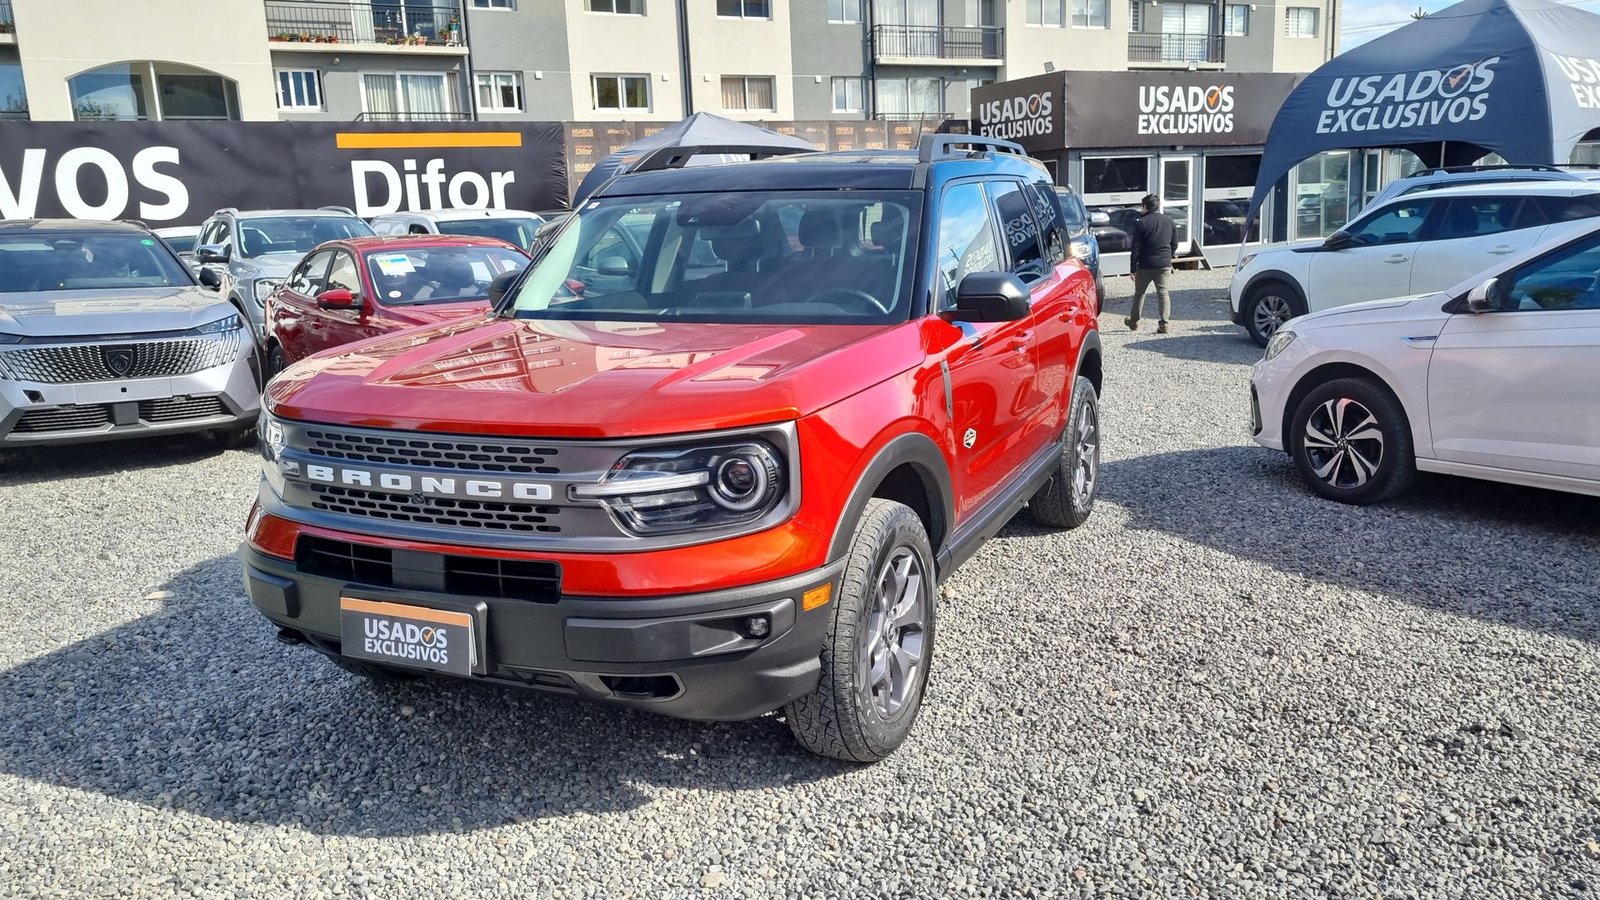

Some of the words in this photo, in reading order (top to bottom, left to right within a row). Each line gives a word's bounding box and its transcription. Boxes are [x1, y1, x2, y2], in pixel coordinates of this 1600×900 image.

[1327, 57, 1500, 107] USADOS
[1570, 83, 1600, 108] EX
[980, 91, 1052, 125] USADOS
[1139, 85, 1234, 113] USADOS
[1316, 93, 1489, 134] EXCLUSIVOS
[980, 116, 1053, 140] EXCLUSIVOS
[1138, 113, 1234, 134] EXCLUSIVOS
[351, 158, 515, 218] Difor
[307, 464, 552, 500] BRONCO
[364, 617, 448, 648] USADOS
[364, 638, 449, 665] EXCLUSIVOS
